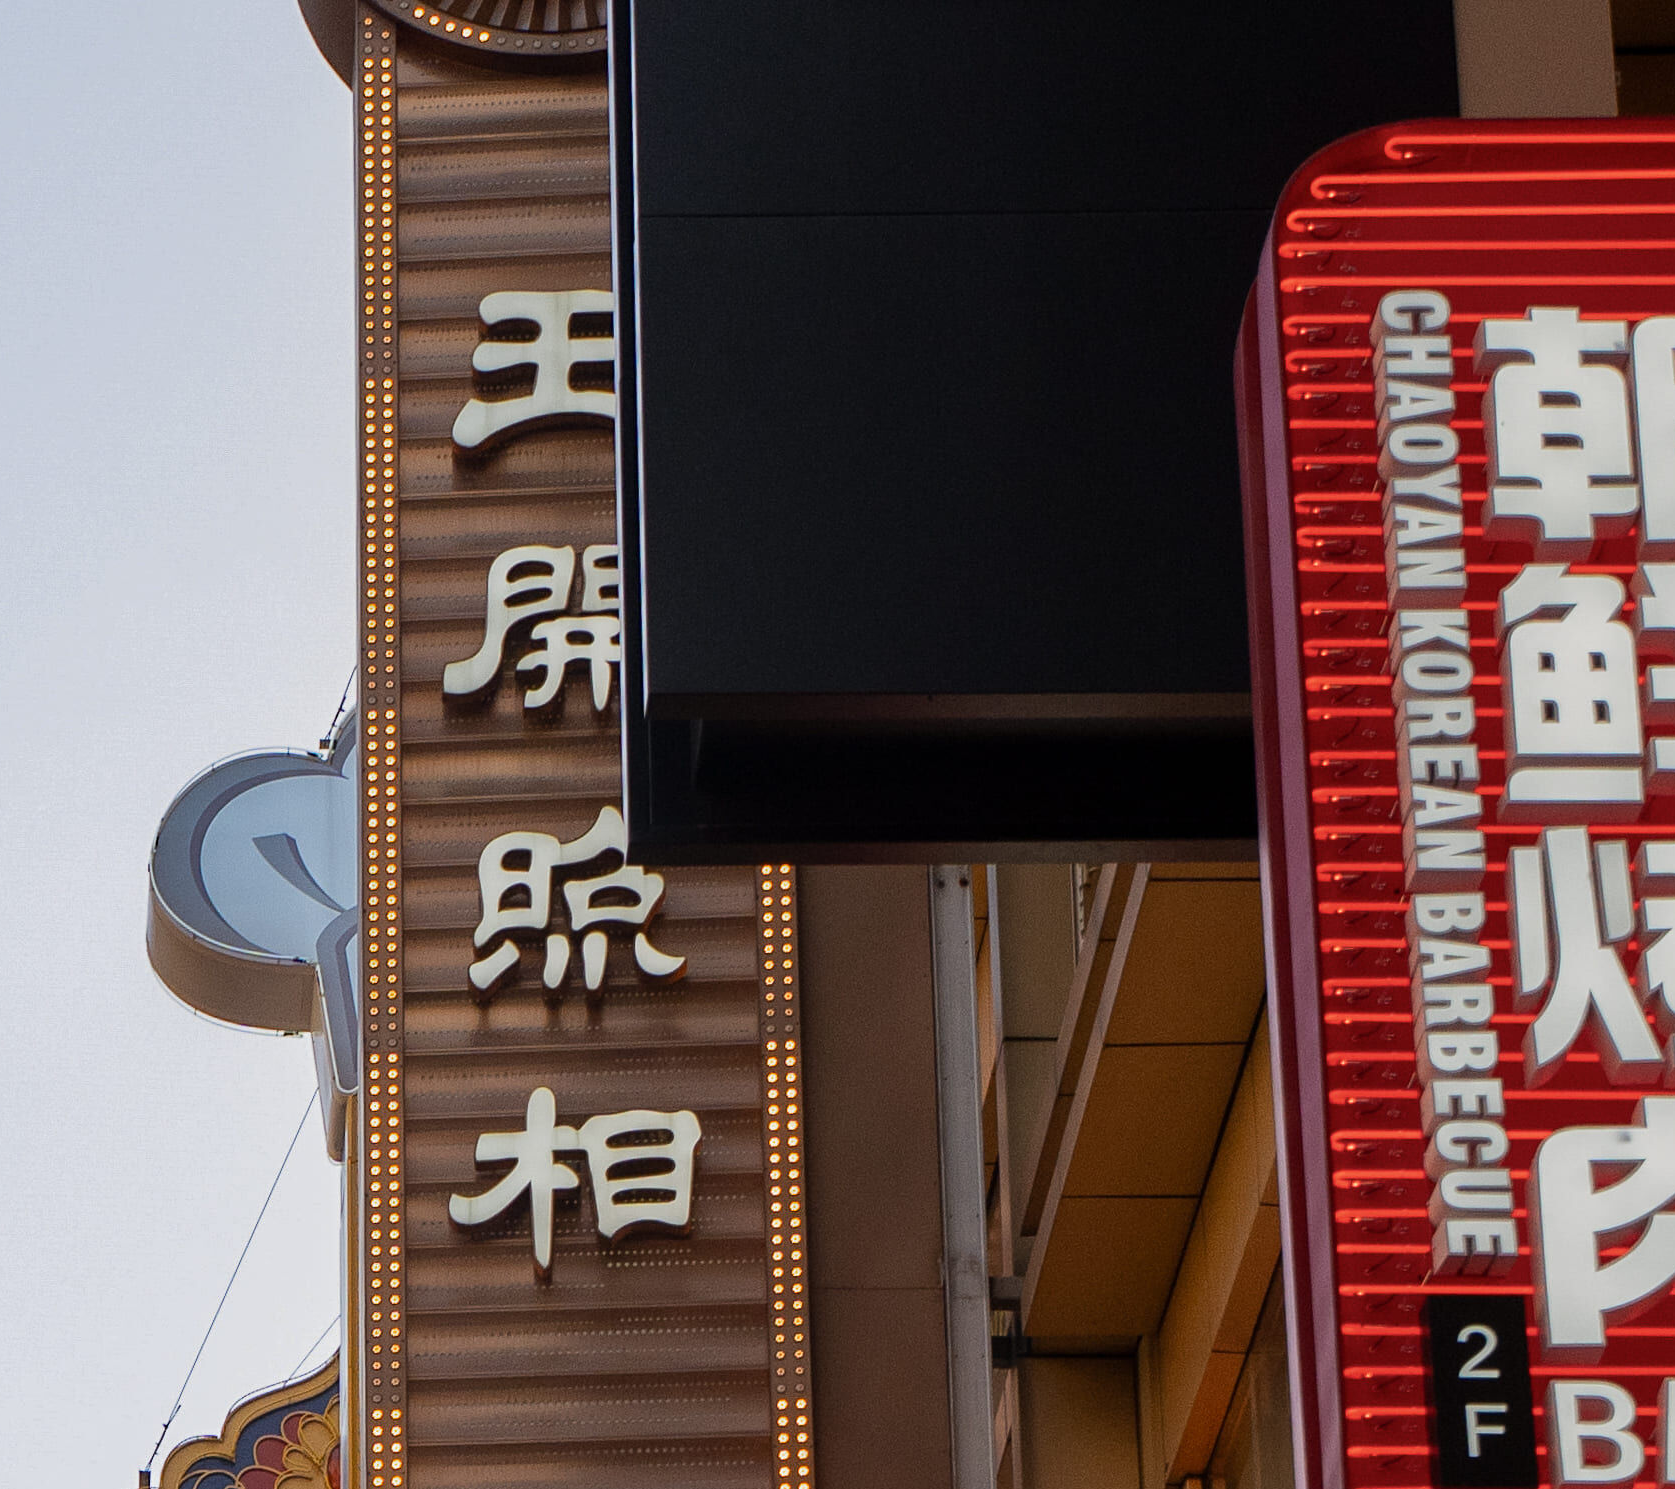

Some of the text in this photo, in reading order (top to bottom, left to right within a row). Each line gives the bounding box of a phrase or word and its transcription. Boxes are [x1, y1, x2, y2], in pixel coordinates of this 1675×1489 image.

[1377, 289, 1519, 1263] CHAOYAN KOREAN BARBECUE
